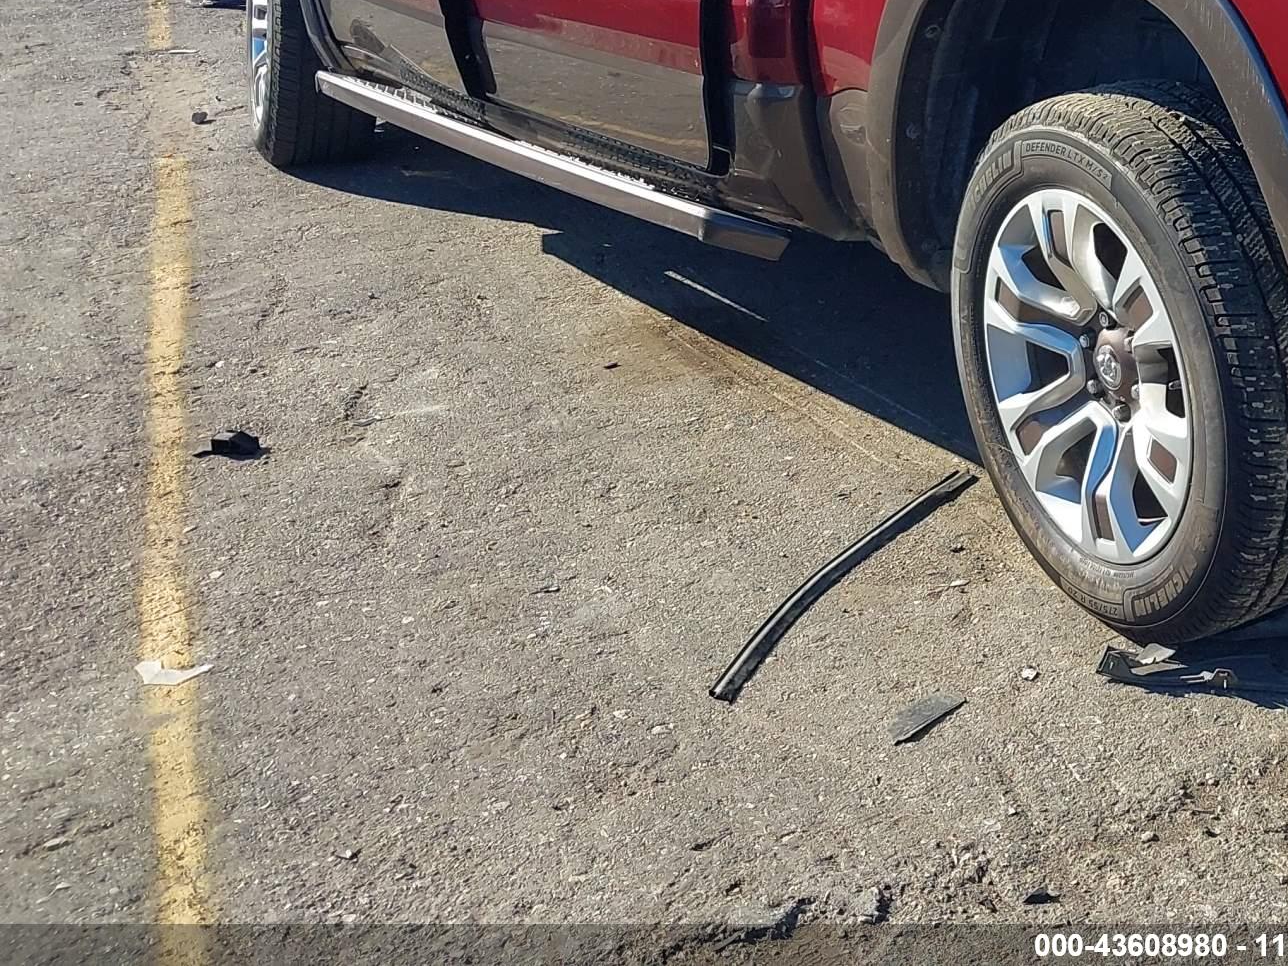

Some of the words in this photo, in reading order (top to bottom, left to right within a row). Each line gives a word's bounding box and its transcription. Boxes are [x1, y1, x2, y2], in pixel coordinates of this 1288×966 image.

[1025, 143, 1067, 156] DEFENDER
[1067, 149, 1084, 164] LTX
[1089, 599, 1118, 615] 275/55
